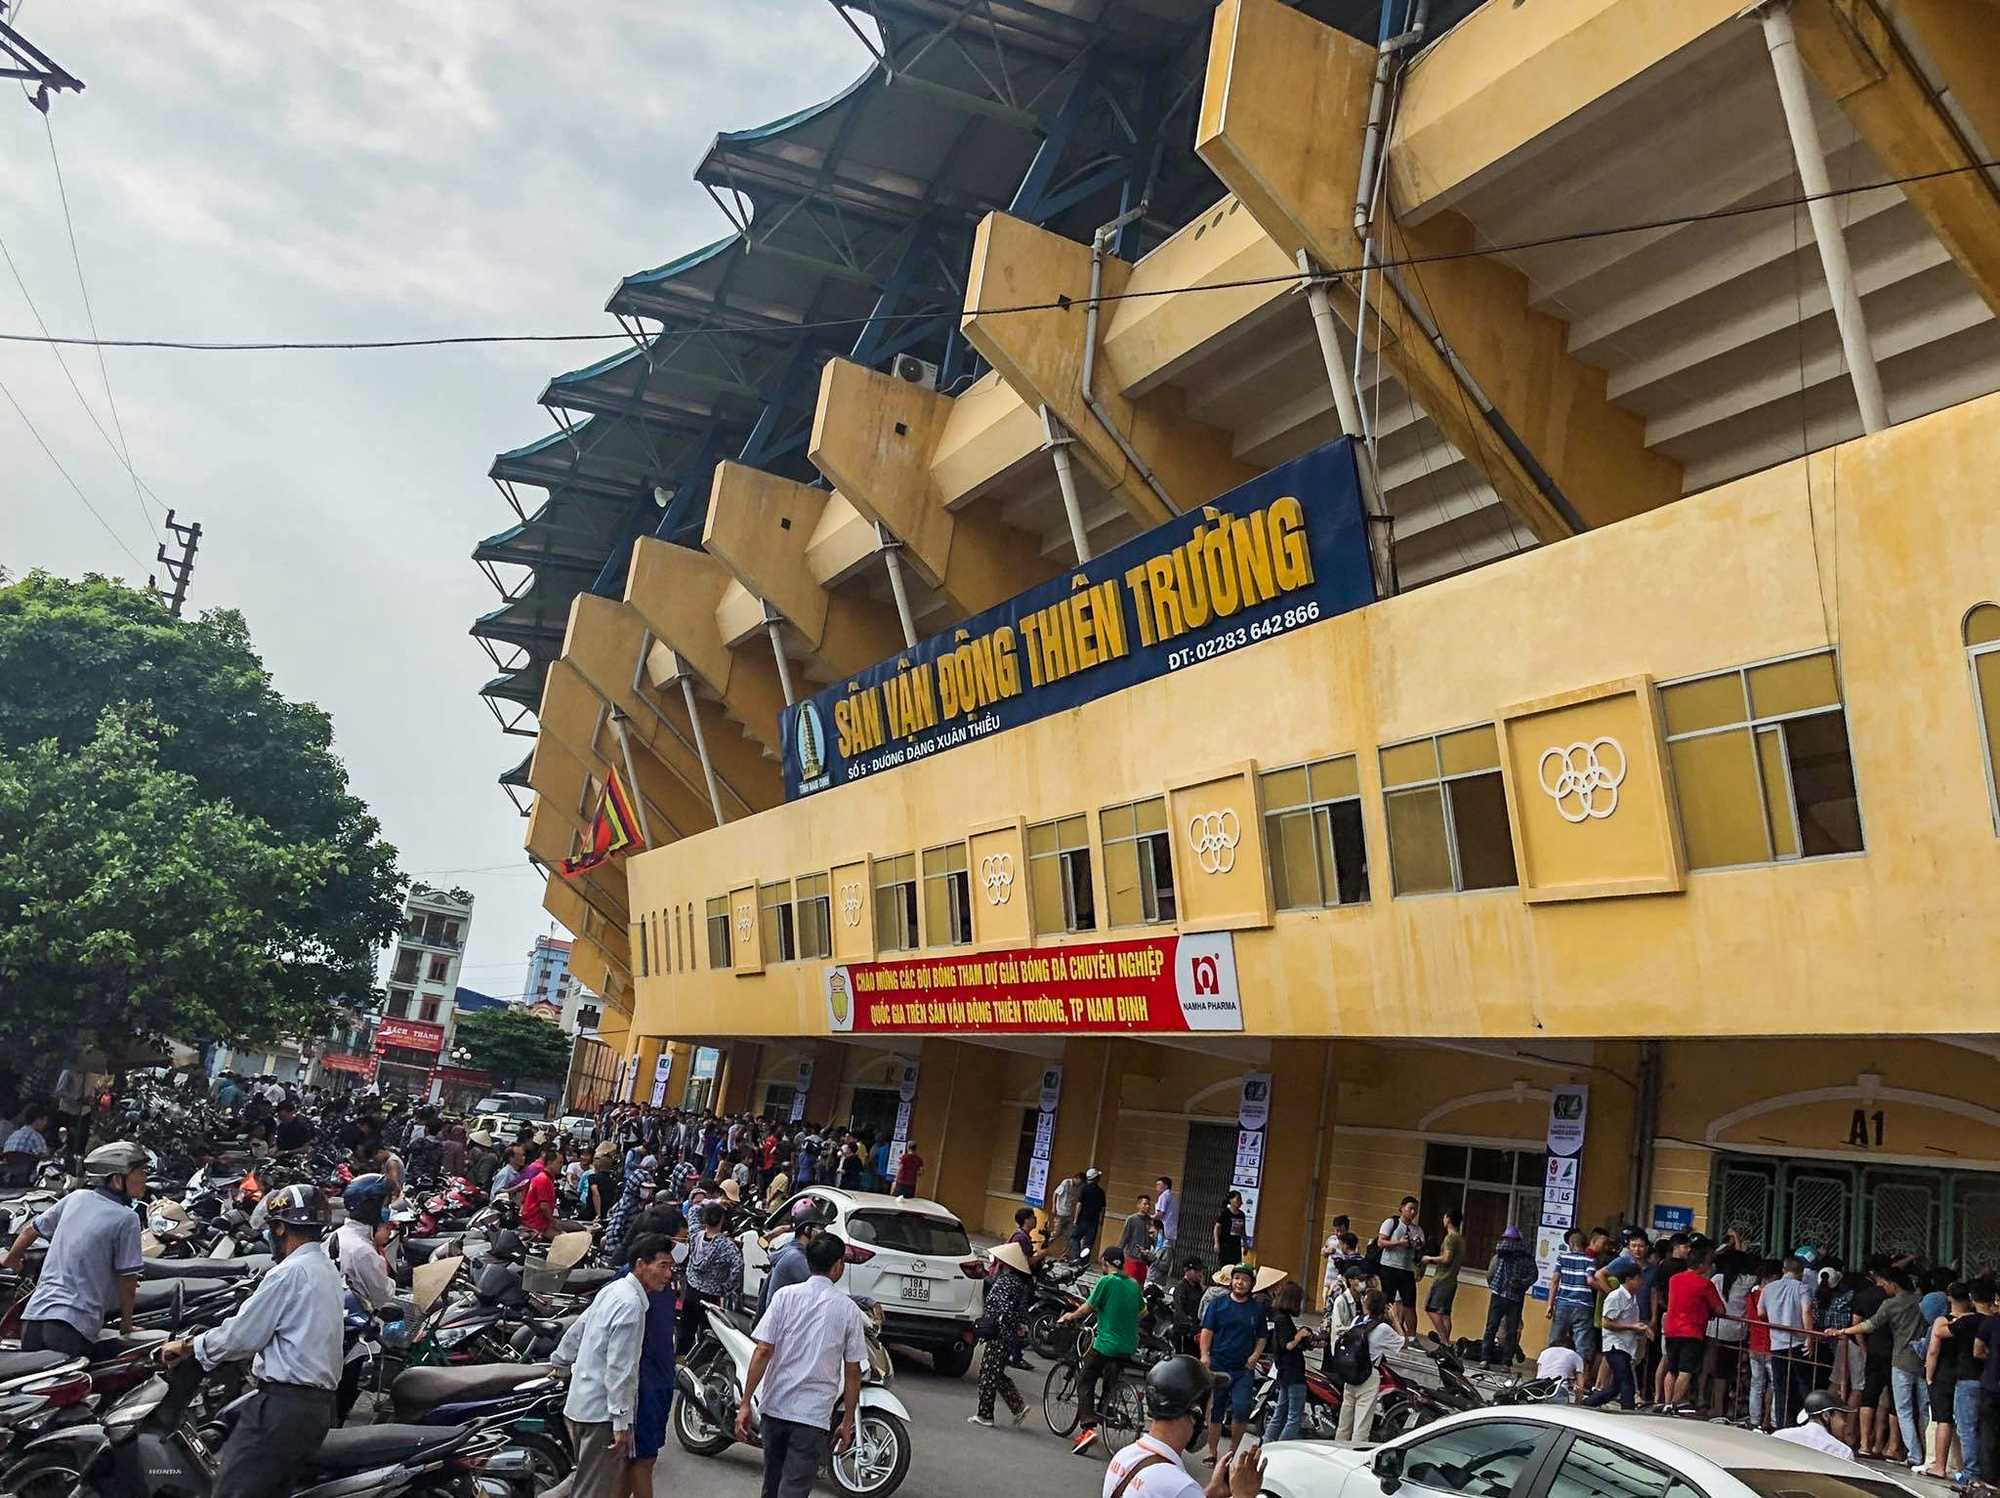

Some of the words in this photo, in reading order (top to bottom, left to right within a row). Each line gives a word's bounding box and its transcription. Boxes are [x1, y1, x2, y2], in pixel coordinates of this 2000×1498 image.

[835, 681, 886, 759] SÂN
[883, 657, 938, 742] VẬN
[937, 628, 1023, 722] ĐỘNG
[1019, 572, 1130, 688] THIÊN
[1125, 496, 1315, 648] TRƯỜNG
[848, 760, 860, 779] SỐ
[861, 763, 867, 775] 5
[936, 726, 967, 749] XUÂN
[968, 712, 1000, 737] THIỀU
[900, 965, 917, 989] CÁC
[917, 964, 932, 992] ĐỘI
[932, 962, 957, 988] BÓNG
[958, 963, 983, 987] THAM
[984, 961, 998, 990] DỰ
[1000, 953, 1020, 985] GIẢI
[1020, 955, 1050, 983] BÓNG
[1051, 952, 1068, 981] ĐÁ
[1069, 949, 1116, 981] CHUYÊN
[1118, 945, 1164, 982] NGHIỆP
[870, 997, 891, 1026] QUỐC
[891, 1003, 906, 1024] GIA
[906, 1000, 927, 1024] TRÊN
[928, 999, 947, 1024] SÂN
[947, 998, 966, 1028] VẬN
[966, 997, 993, 1028] ĐỘNG
[993, 996, 1022, 1024] THIÊN
[1022, 993, 1069, 1026] TRƯỜNG,
[1069, 997, 1084, 1022] TP
[1086, 997, 1116, 1022] NAM
[1117, 995, 1149, 1028] ĐỊNH
[1183, 1002, 1206, 1011] NAMHA
[1208, 1001, 1237, 1011] PHARMA
[1849, 1109, 1884, 1146] A1
[910, 1277, 923, 1288] 18A
